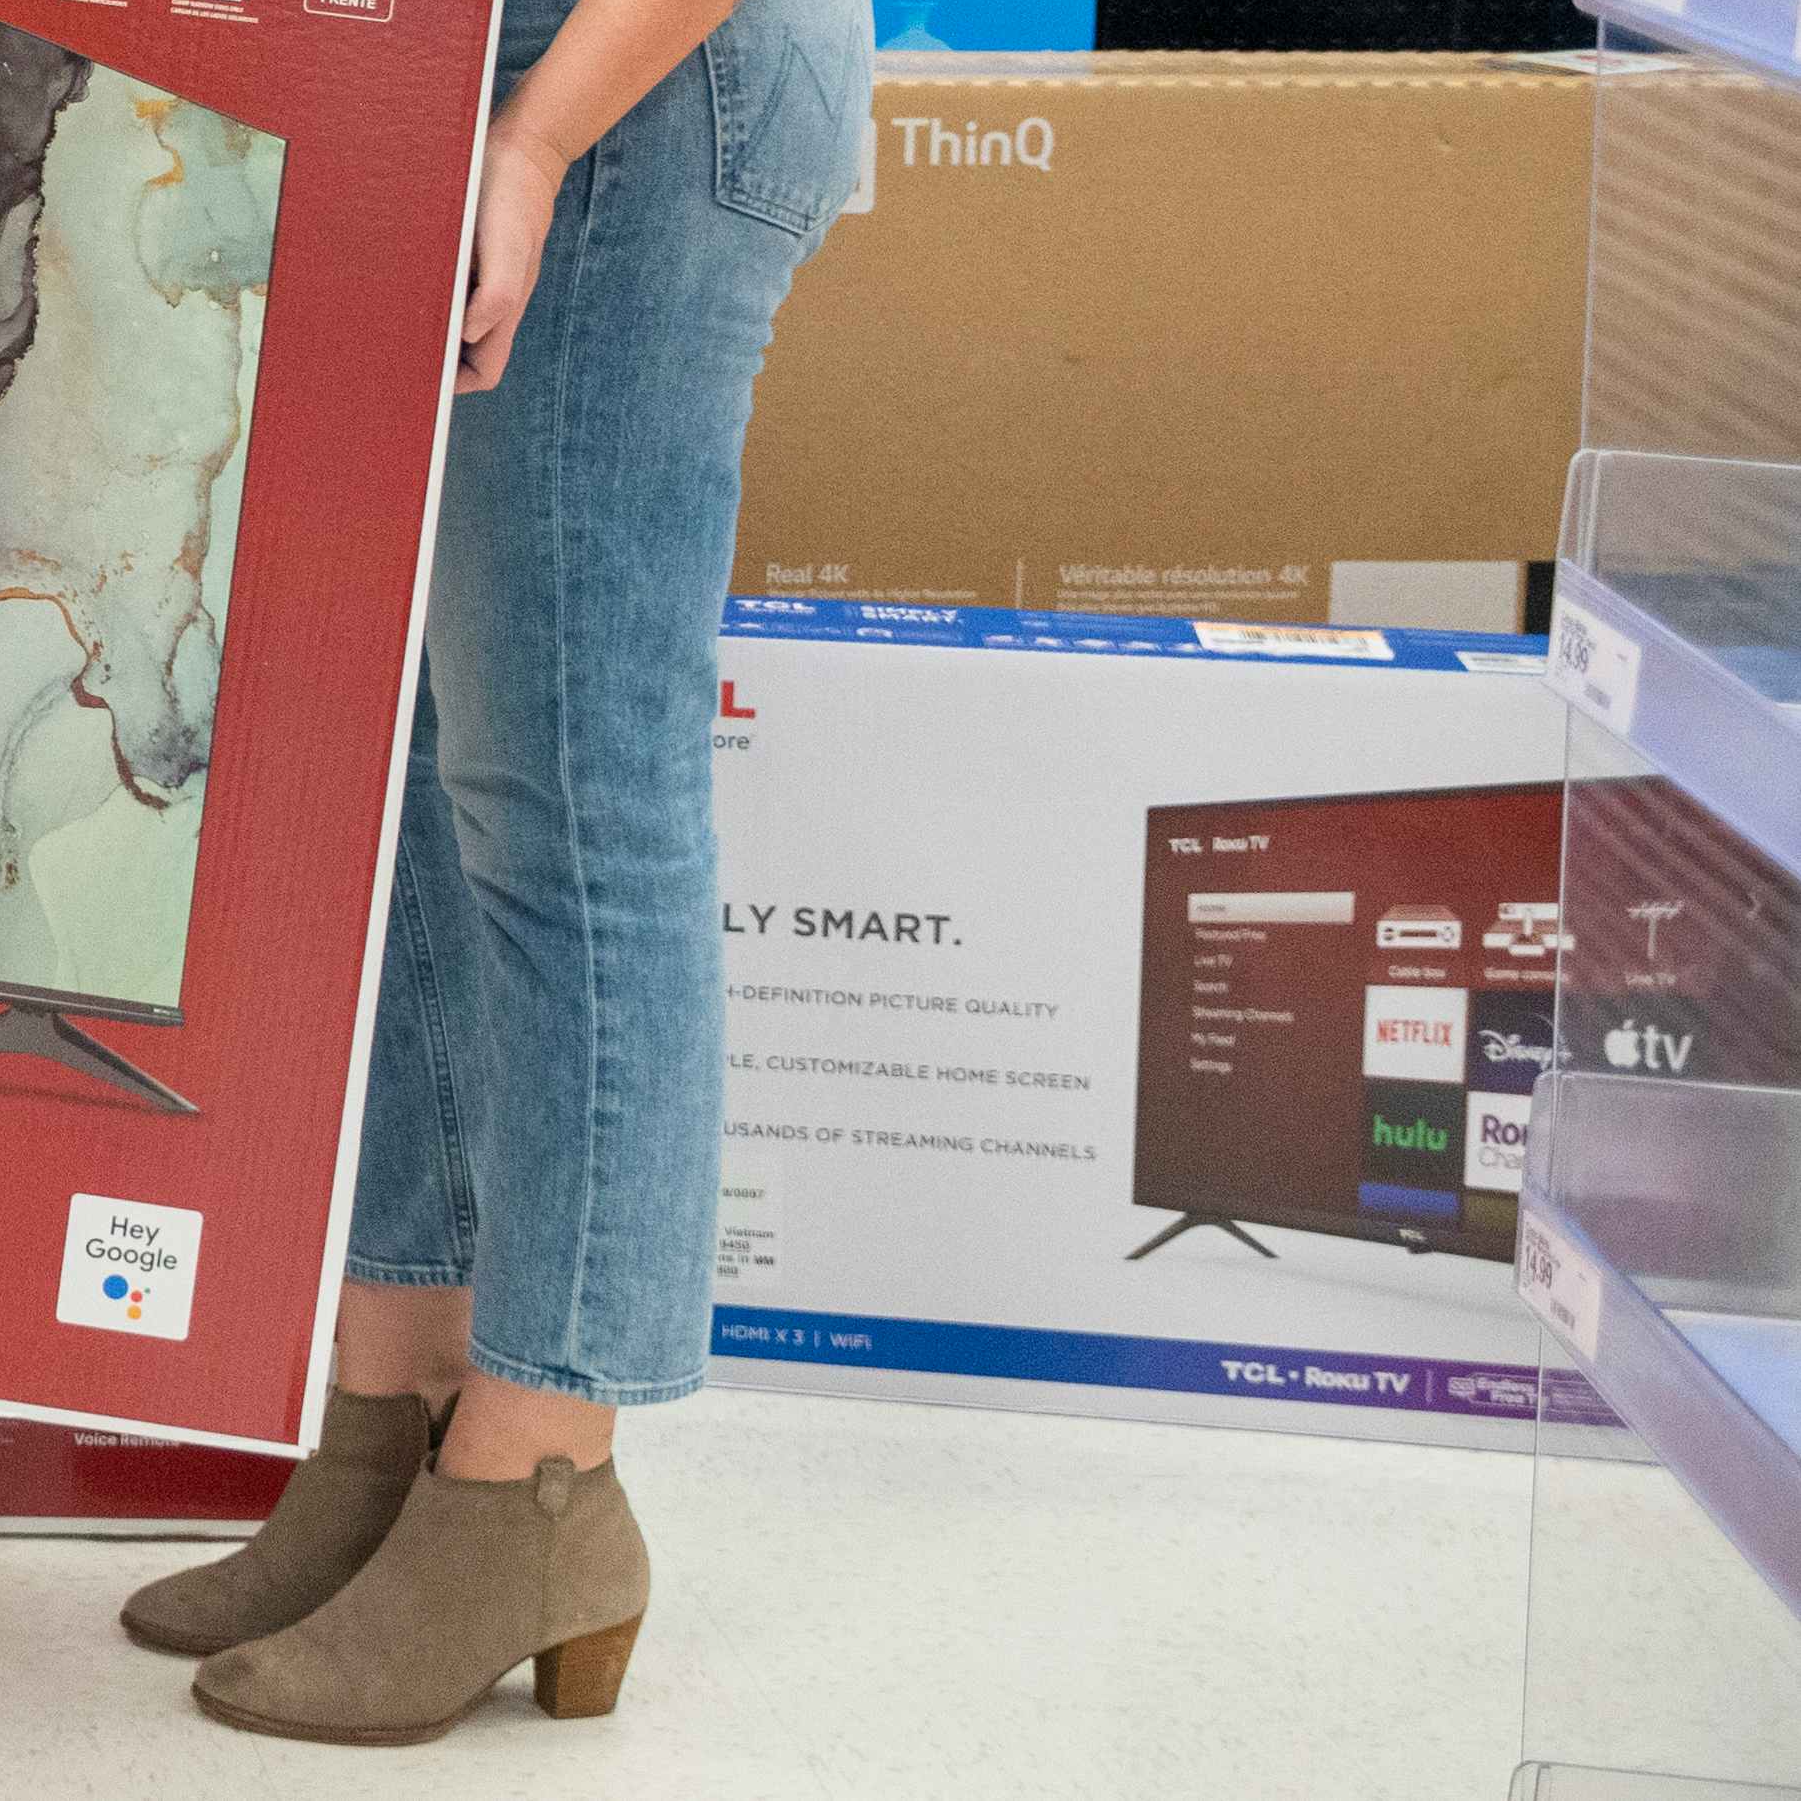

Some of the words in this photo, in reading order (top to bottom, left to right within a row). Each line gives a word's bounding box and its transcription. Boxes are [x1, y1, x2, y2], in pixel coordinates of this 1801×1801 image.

[890, 116, 1056, 173] ThinQ
[765, 562, 814, 585] Real
[817, 563, 850, 585] 4K
[1168, 836, 1203, 854] TCL
[1249, 835, 1271, 852] TV
[795, 906, 963, 946] SMART.
[869, 991, 958, 1014] PICTURE
[965, 998, 1059, 1020] QUALITY
[1376, 1019, 1454, 1047] NETFLIX
[1643, 1024, 1694, 1073] tv
[766, 1055, 930, 1080] CUSTOMIZABLE
[936, 1066, 998, 1085] HOME
[1005, 1070, 1091, 1091] SCREEN
[723, 1121, 808, 1141] USANDS
[814, 1127, 846, 1144] OF
[851, 1129, 974, 1154] STREAMING
[979, 1138, 1097, 1161] CHANNELS
[1372, 1113, 1449, 1152] hulu
[108, 1215, 161, 1247] Hey
[724, 1226, 775, 1239] Vietnam
[85, 1237, 179, 1273] Google
[1220, 1359, 1285, 1386] TCL
[1375, 1370, 1412, 1397] TV
[73, 1432, 120, 1447] Voice
